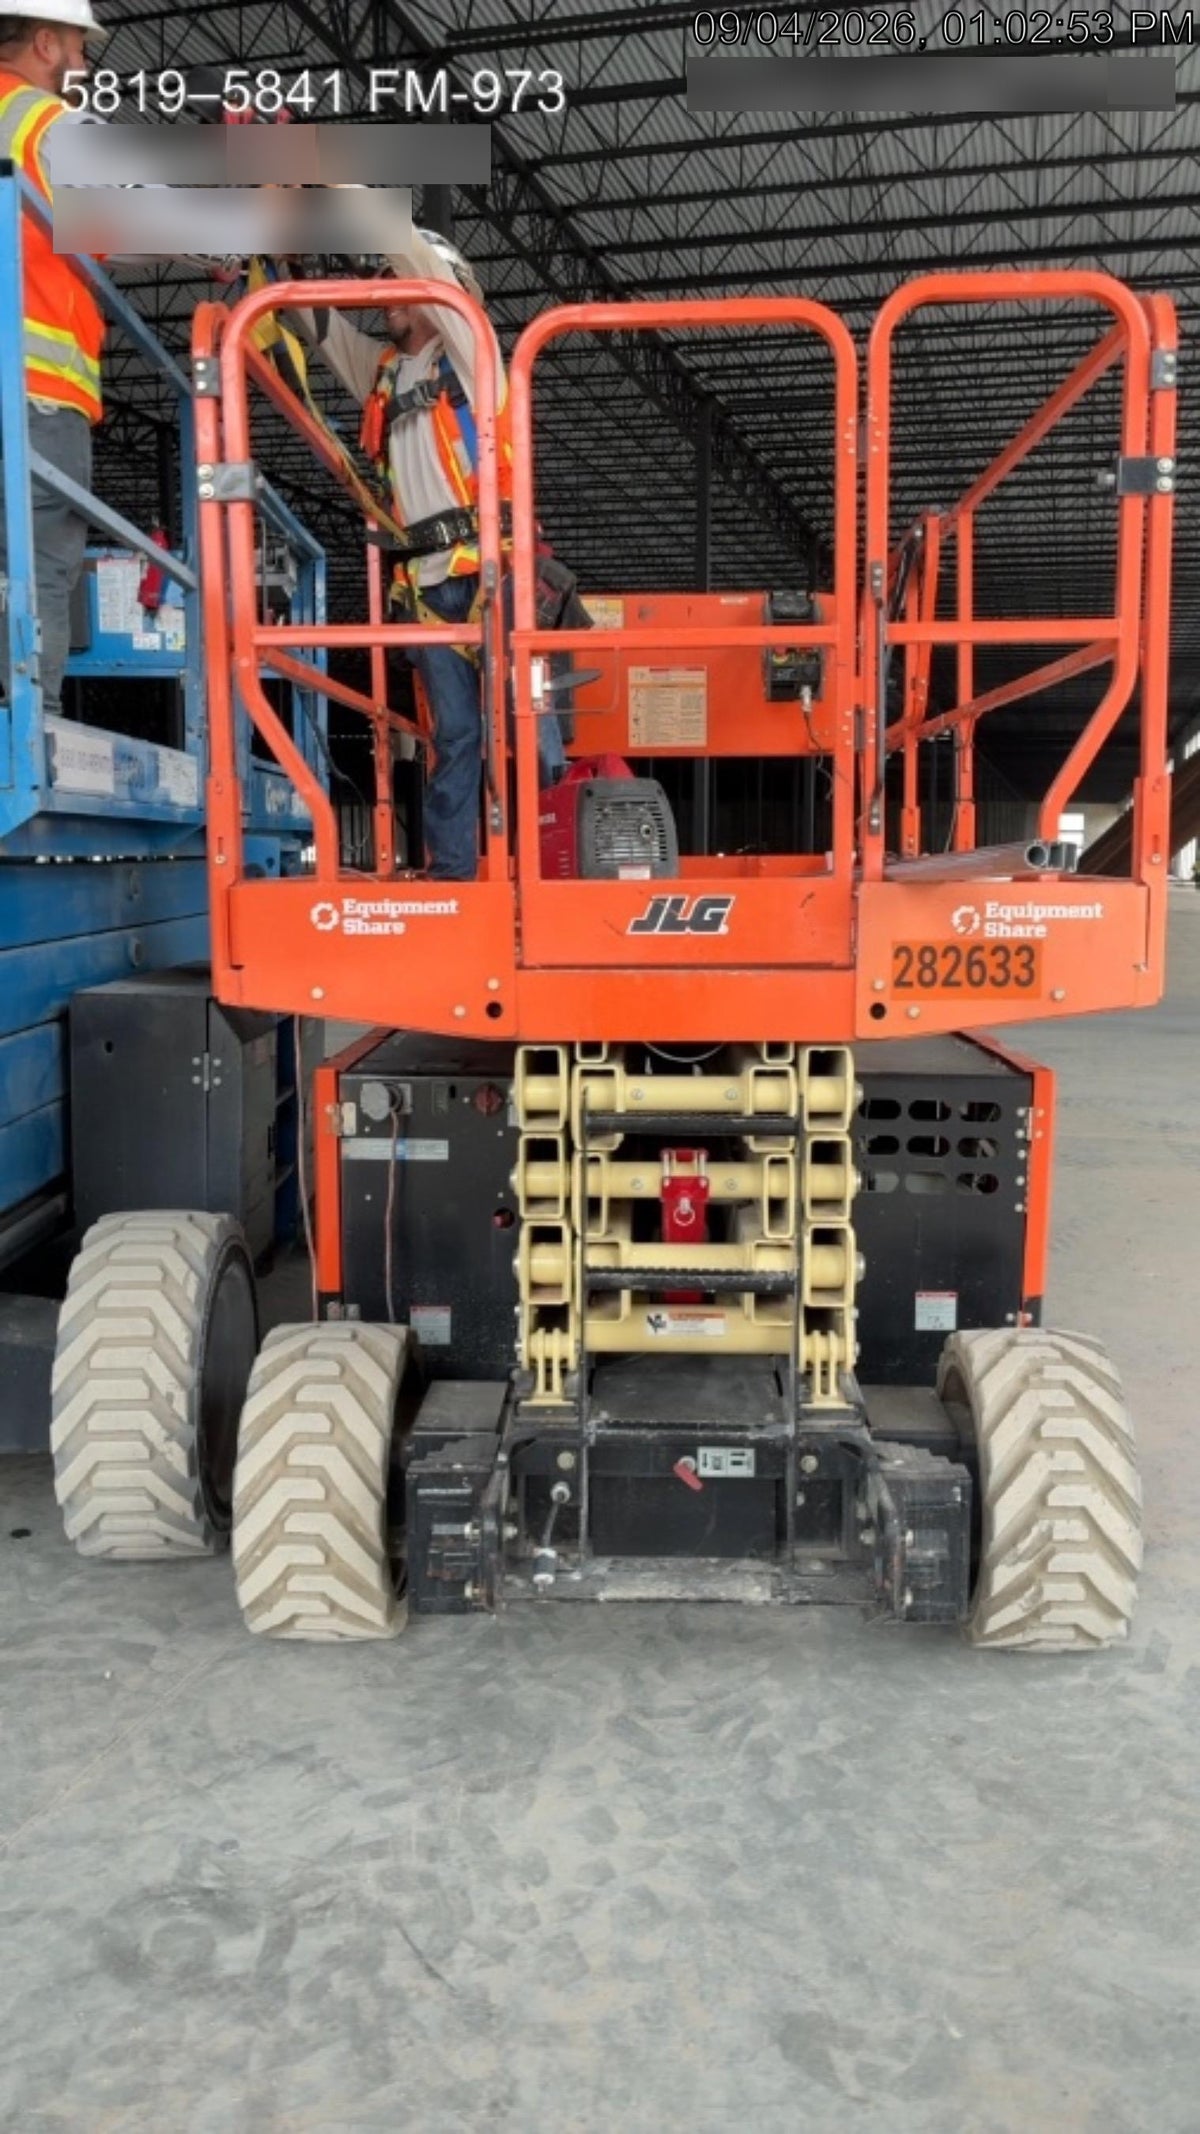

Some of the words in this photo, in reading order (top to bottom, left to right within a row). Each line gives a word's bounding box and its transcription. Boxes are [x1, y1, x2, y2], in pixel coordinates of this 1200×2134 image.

[342, 898, 459, 916] Equipment
[628, 897, 735, 934] JLG
[984, 901, 1104, 920] Equipment
[342, 917, 406, 935] Share
[984, 921, 1047, 939] Share
[894, 945, 1035, 988] 282633
